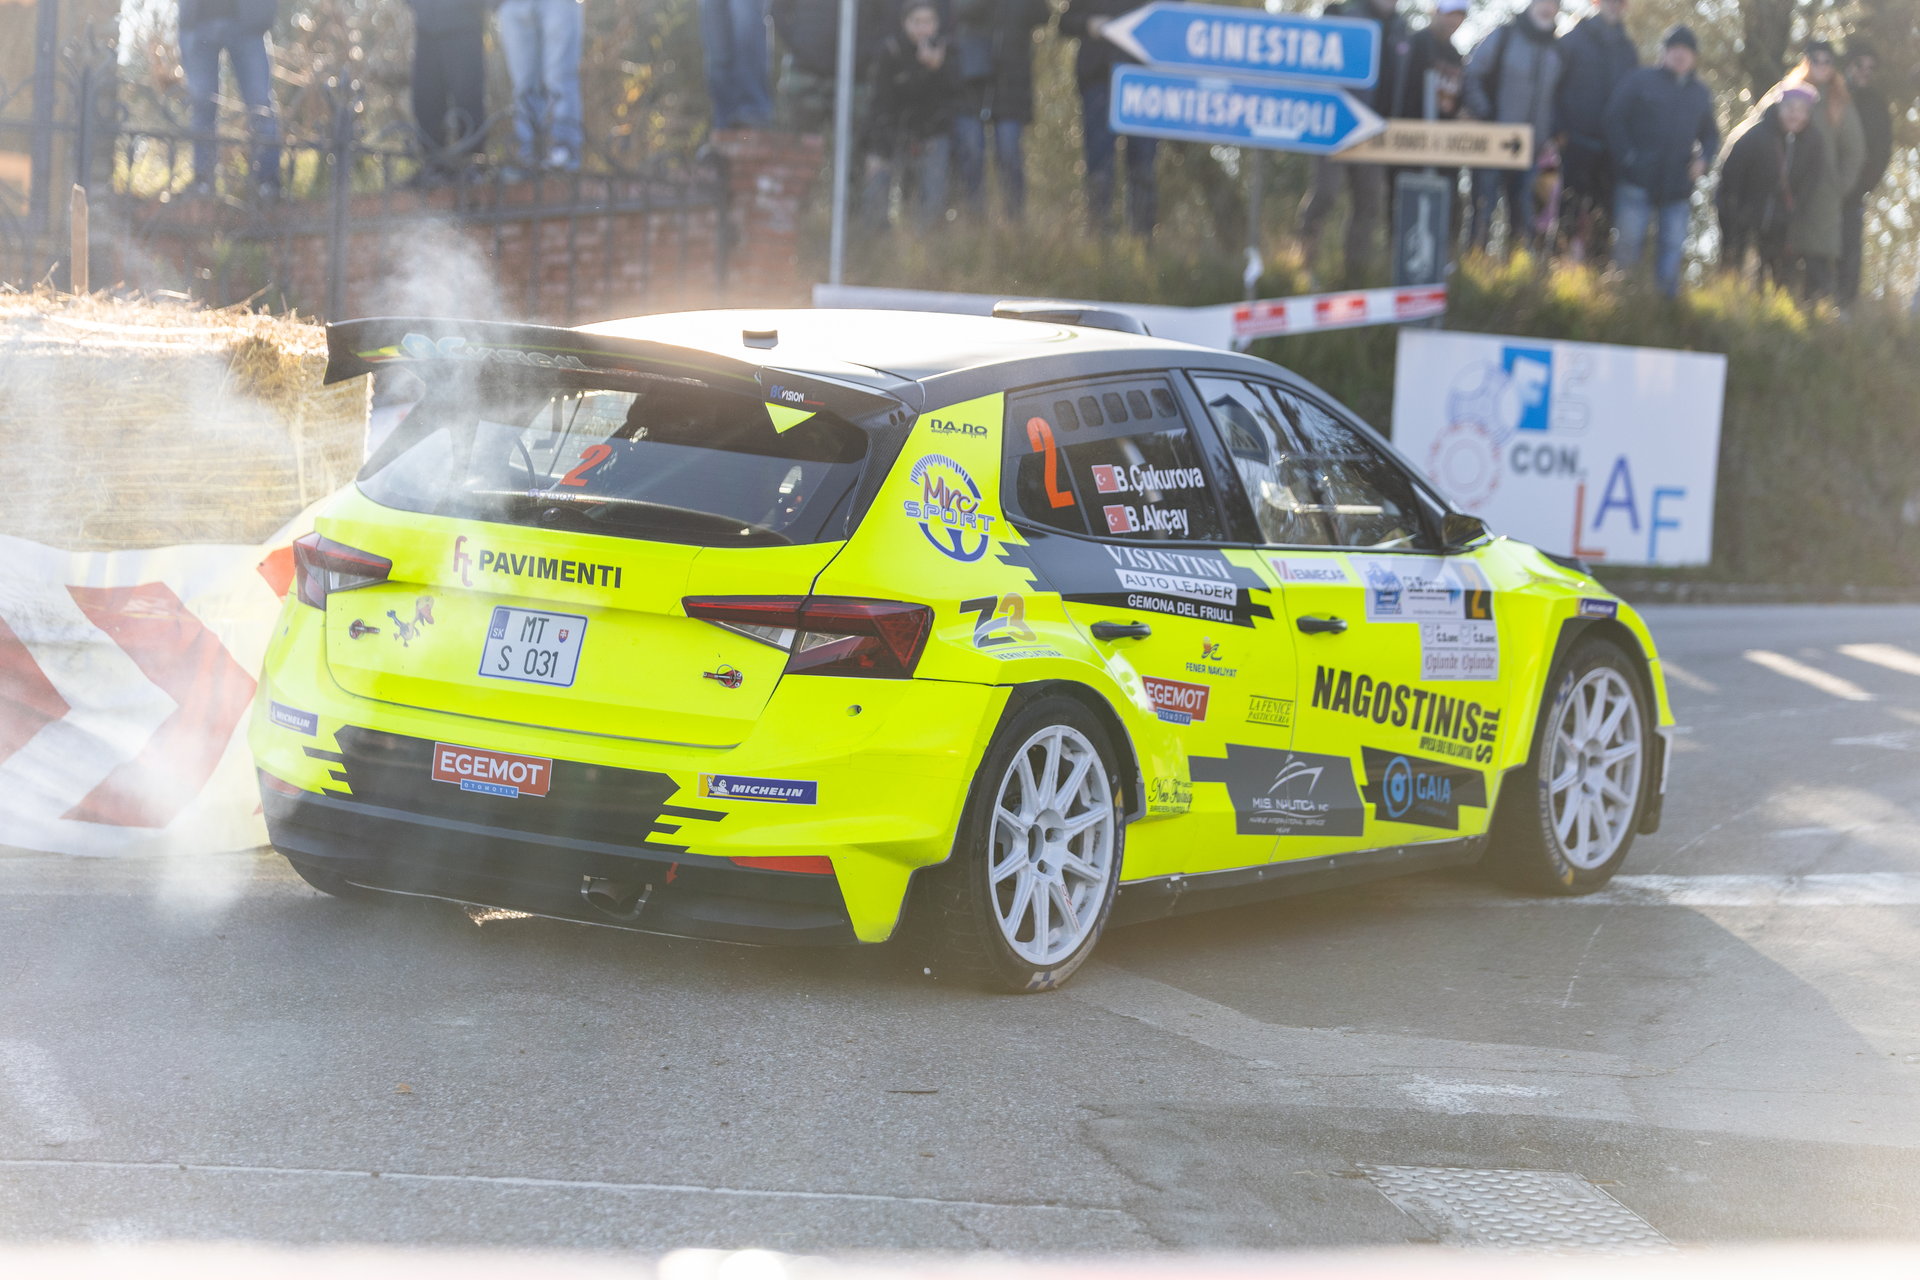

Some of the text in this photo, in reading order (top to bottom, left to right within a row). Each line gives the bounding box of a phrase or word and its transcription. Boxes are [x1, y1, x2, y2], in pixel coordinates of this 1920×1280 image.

[1186, 20, 1344, 71] GINESTRA
[1121, 83, 1337, 138] MONTESPERTOLI
[563, 444, 613, 487] 2
[1026, 416, 1075, 509] 2
[1113, 463, 1205, 496] B.Çukurova
[904, 500, 995, 532] SPORT
[1125, 503, 1189, 536] B.Akçay
[478, 549, 622, 589] PAVIMENTI
[1102, 544, 1232, 580] VISINTINI
[1125, 573, 1233, 600] AUTO LEADER
[1127, 594, 1233, 622] GEMONA DEL FRIULI
[492, 627, 504, 638] SK
[520, 615, 550, 644] MT
[498, 645, 559, 678] S 031
[1185, 662, 1206, 673] FENER
[1145, 682, 1206, 711] EGEMOT
[1248, 698, 1292, 715] LA FENICE
[1311, 665, 1483, 744] NAGOSTINIS
[276, 710, 311, 729] MICHELIN
[1476, 708, 1501, 764] SRL
[440, 751, 544, 787] EGEMOT
[731, 783, 803, 798] MICHELIN
[1416, 773, 1452, 804] GAIA
[1276, 799, 1316, 811] NAUTICA
